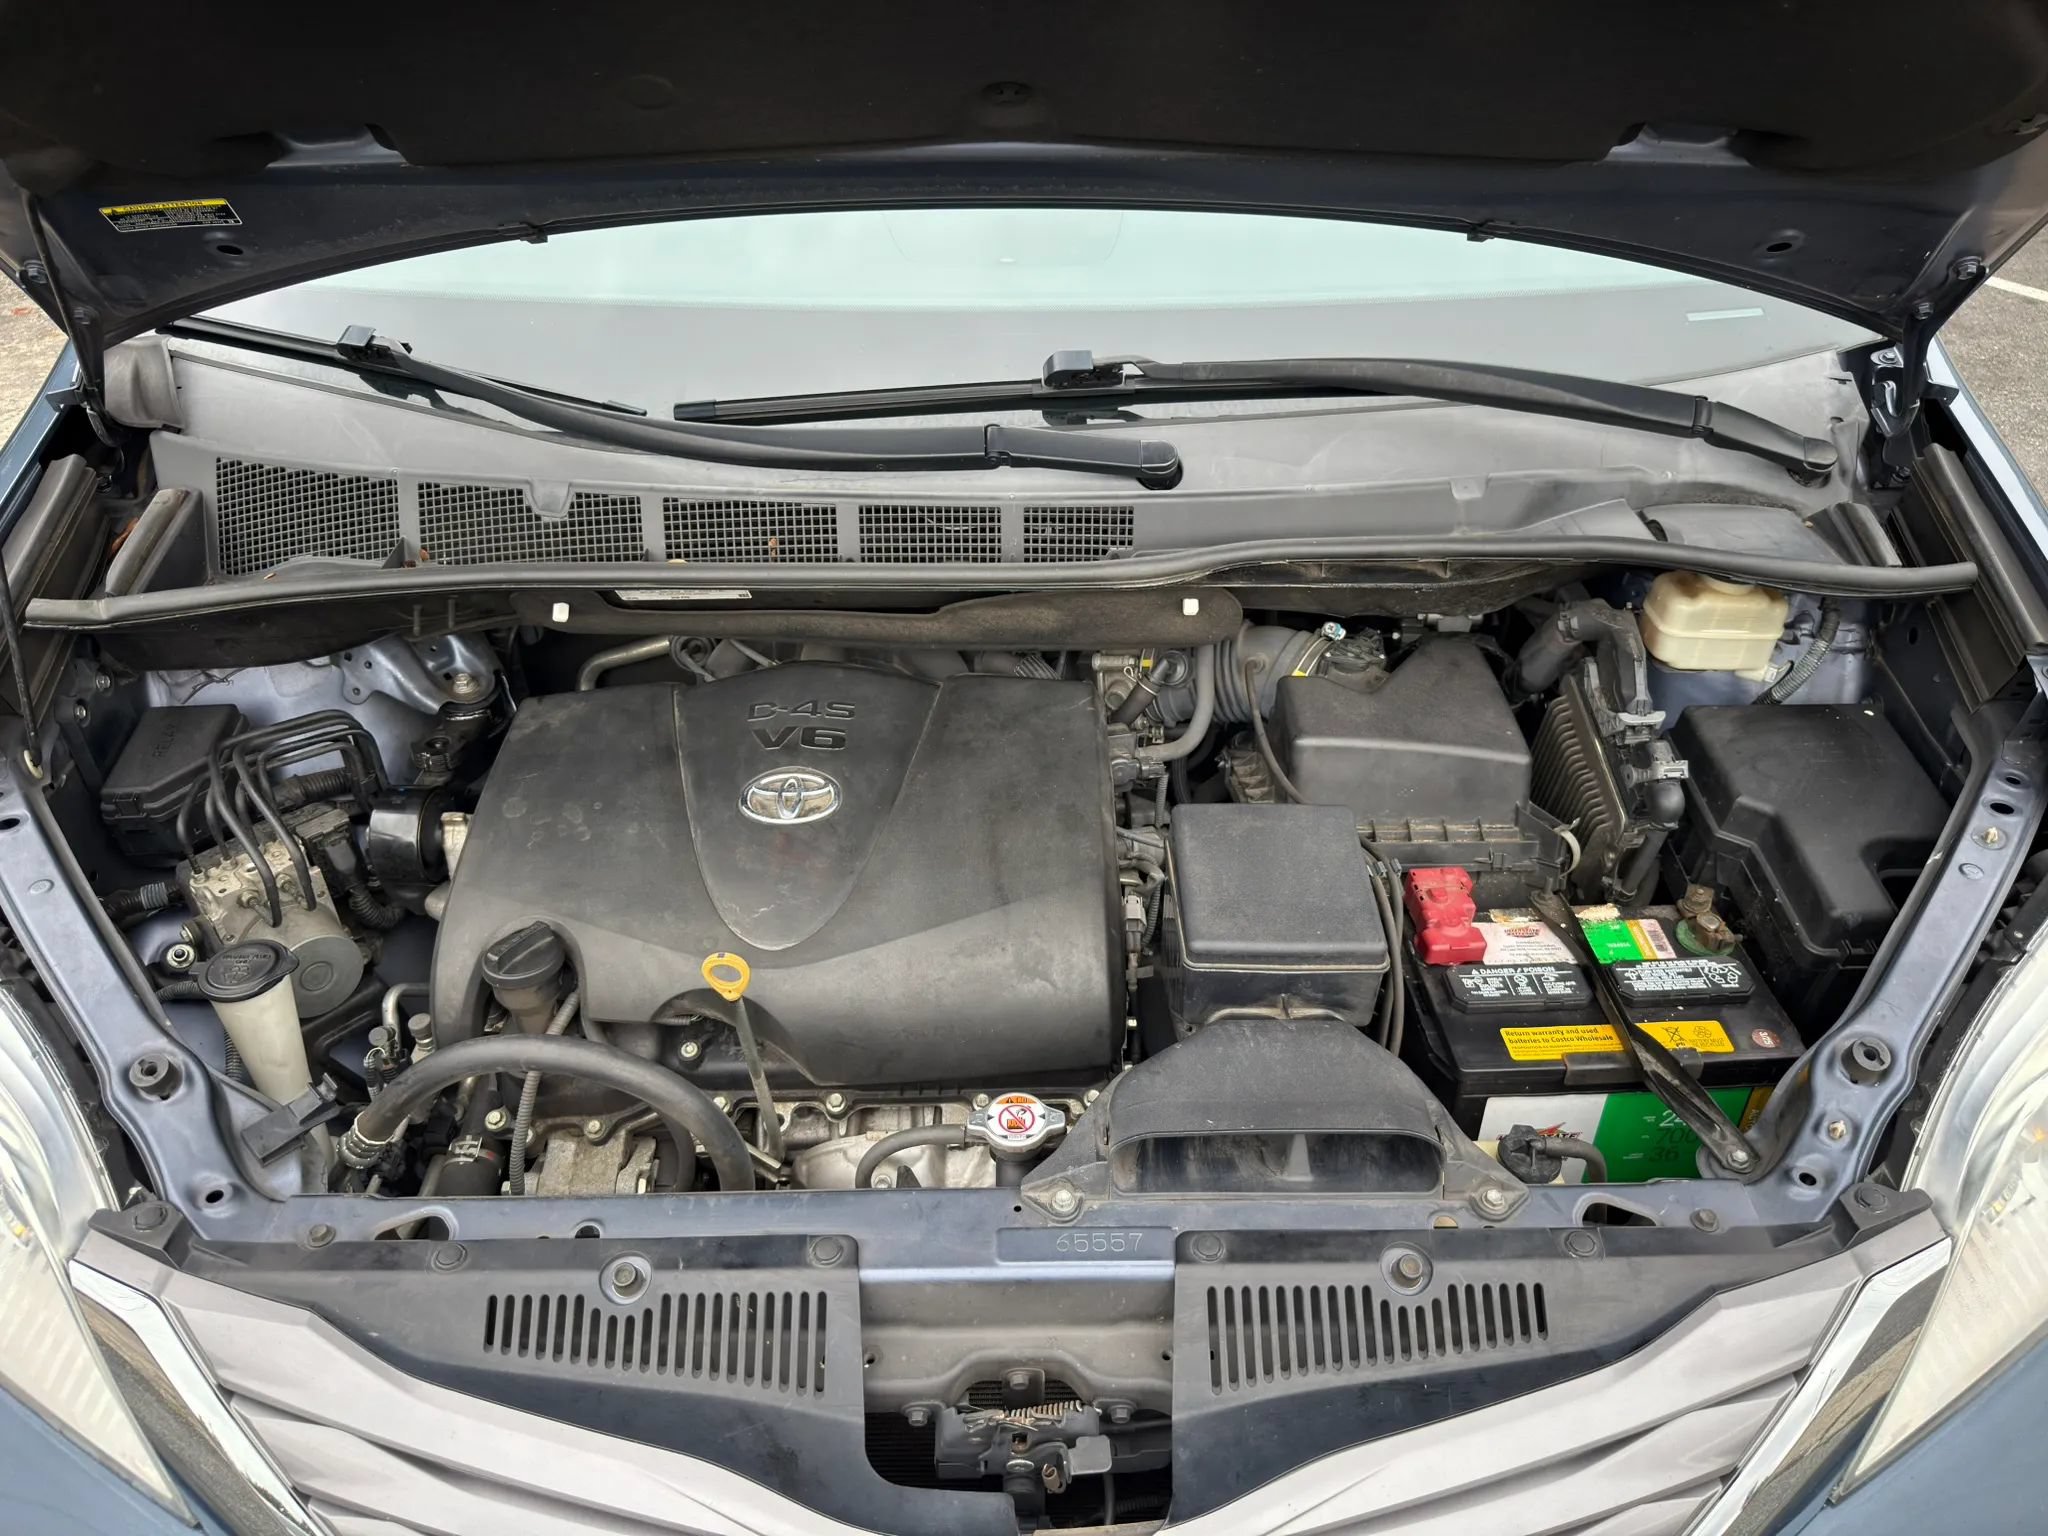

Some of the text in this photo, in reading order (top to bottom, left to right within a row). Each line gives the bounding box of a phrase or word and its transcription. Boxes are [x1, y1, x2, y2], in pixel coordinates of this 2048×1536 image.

[747, 700, 856, 722] D-4S
[751, 726, 847, 751] V6
[1480, 967, 1515, 975] DANGER
[1522, 966, 1556, 974] POISON
[1056, 1232, 1143, 1252] 65557
